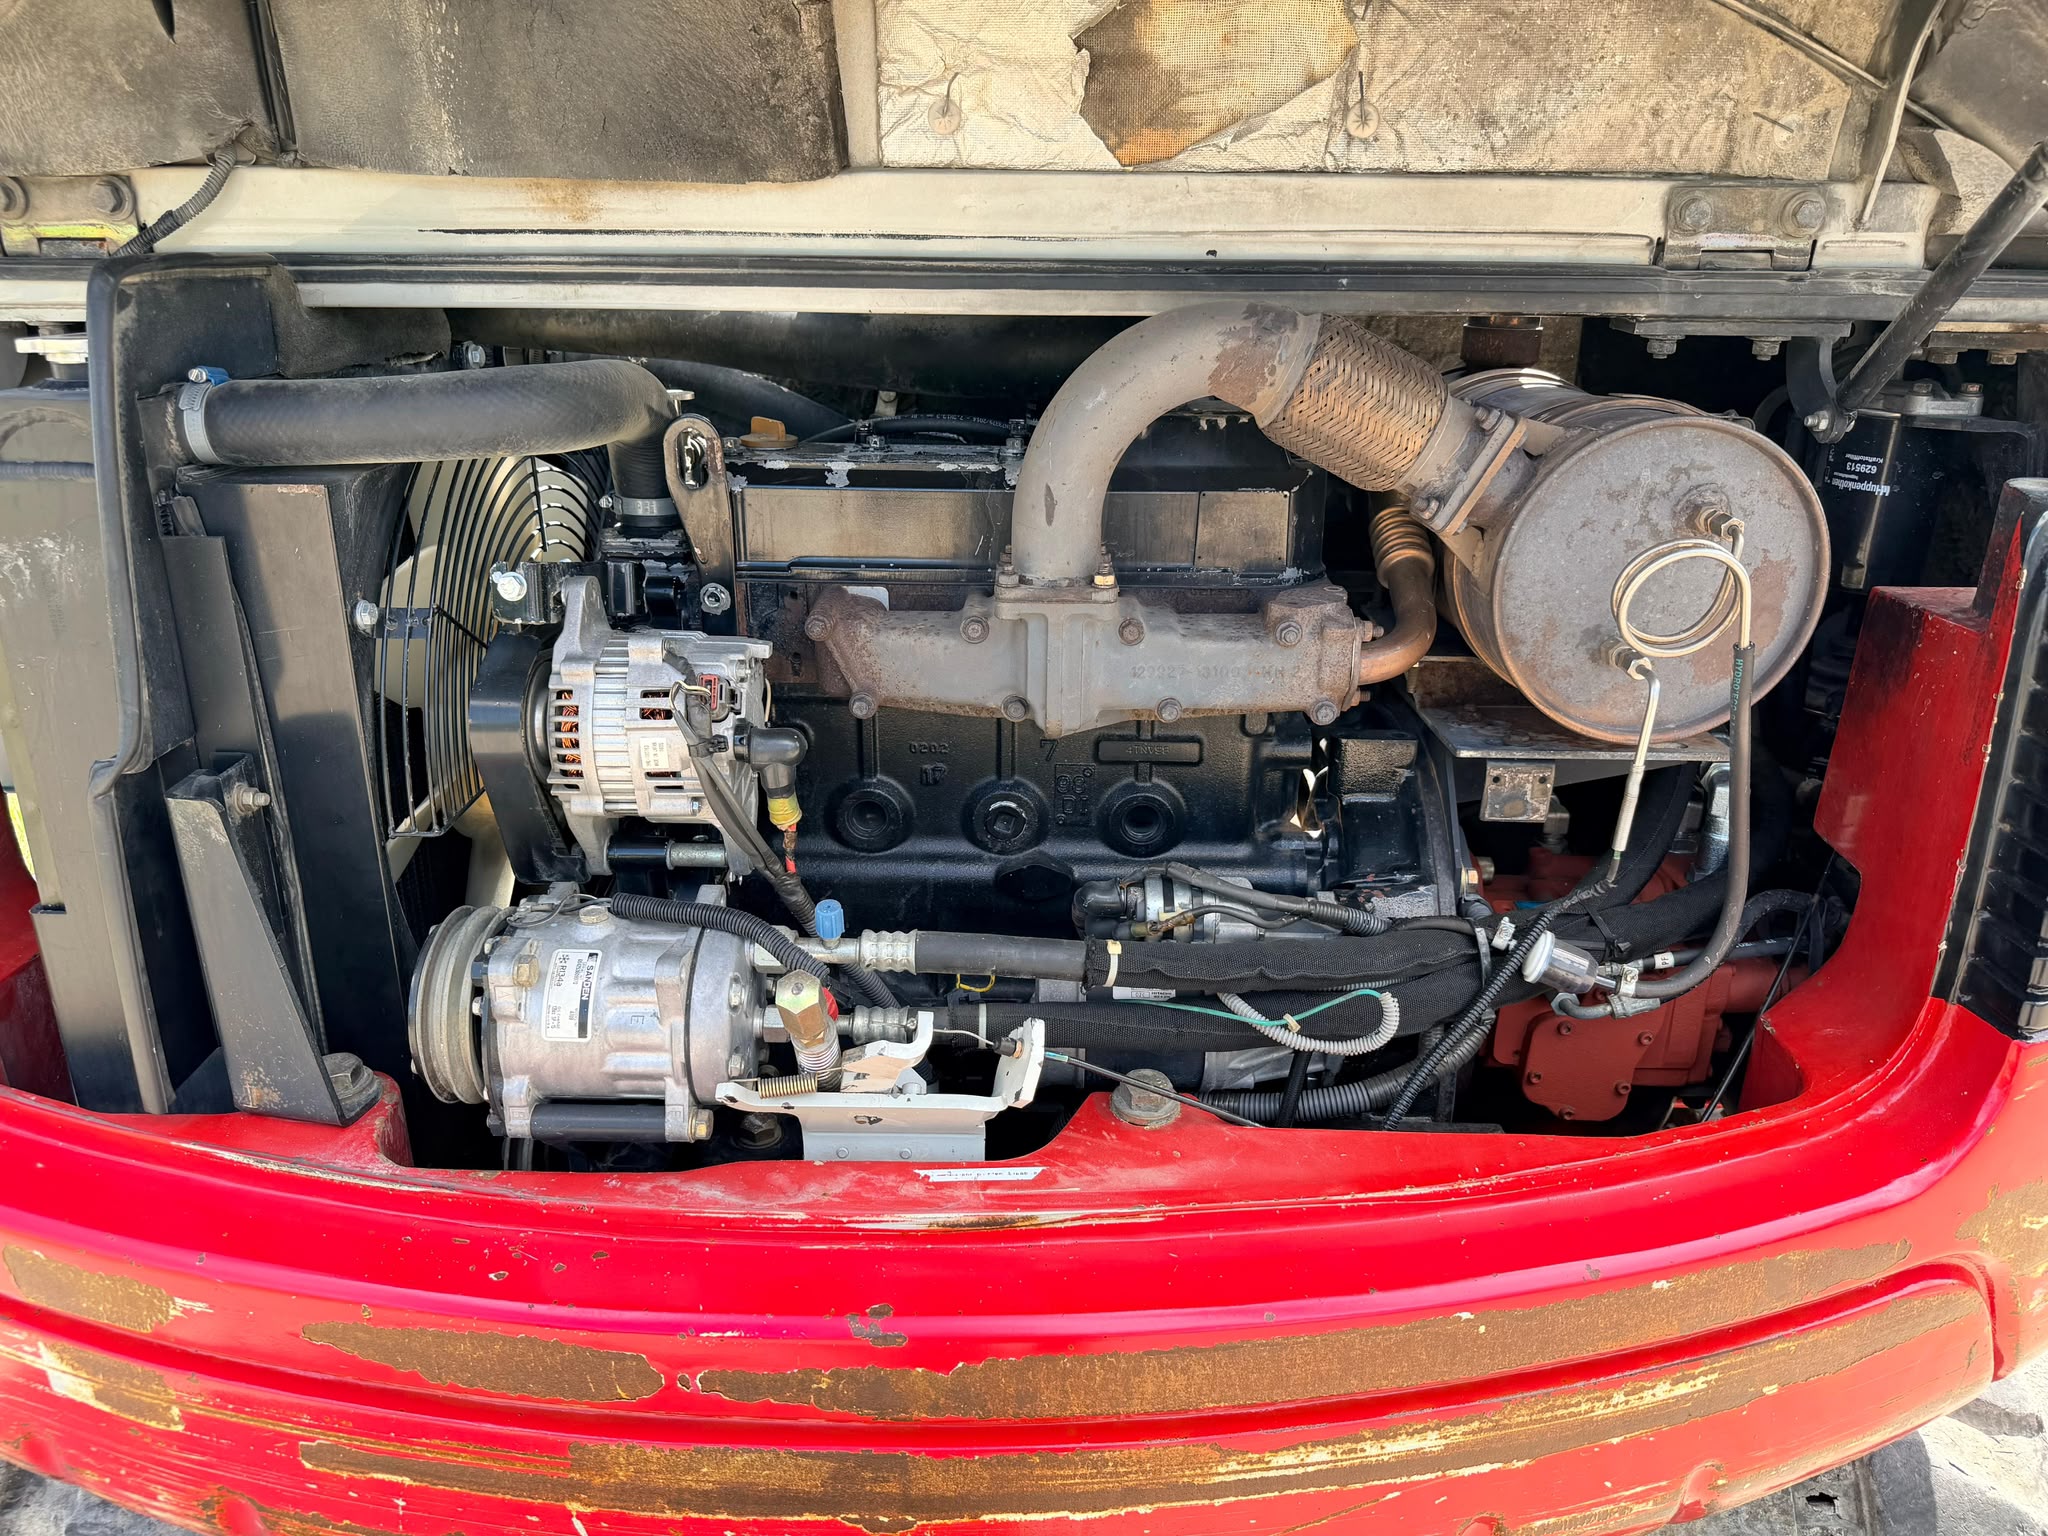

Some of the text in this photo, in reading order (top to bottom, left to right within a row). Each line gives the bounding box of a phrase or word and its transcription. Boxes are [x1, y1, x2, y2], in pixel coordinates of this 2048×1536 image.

[1846, 461, 1877, 474] 629513
[556, 965, 567, 987] R134a
[581, 965, 594, 1000] SANDEN
